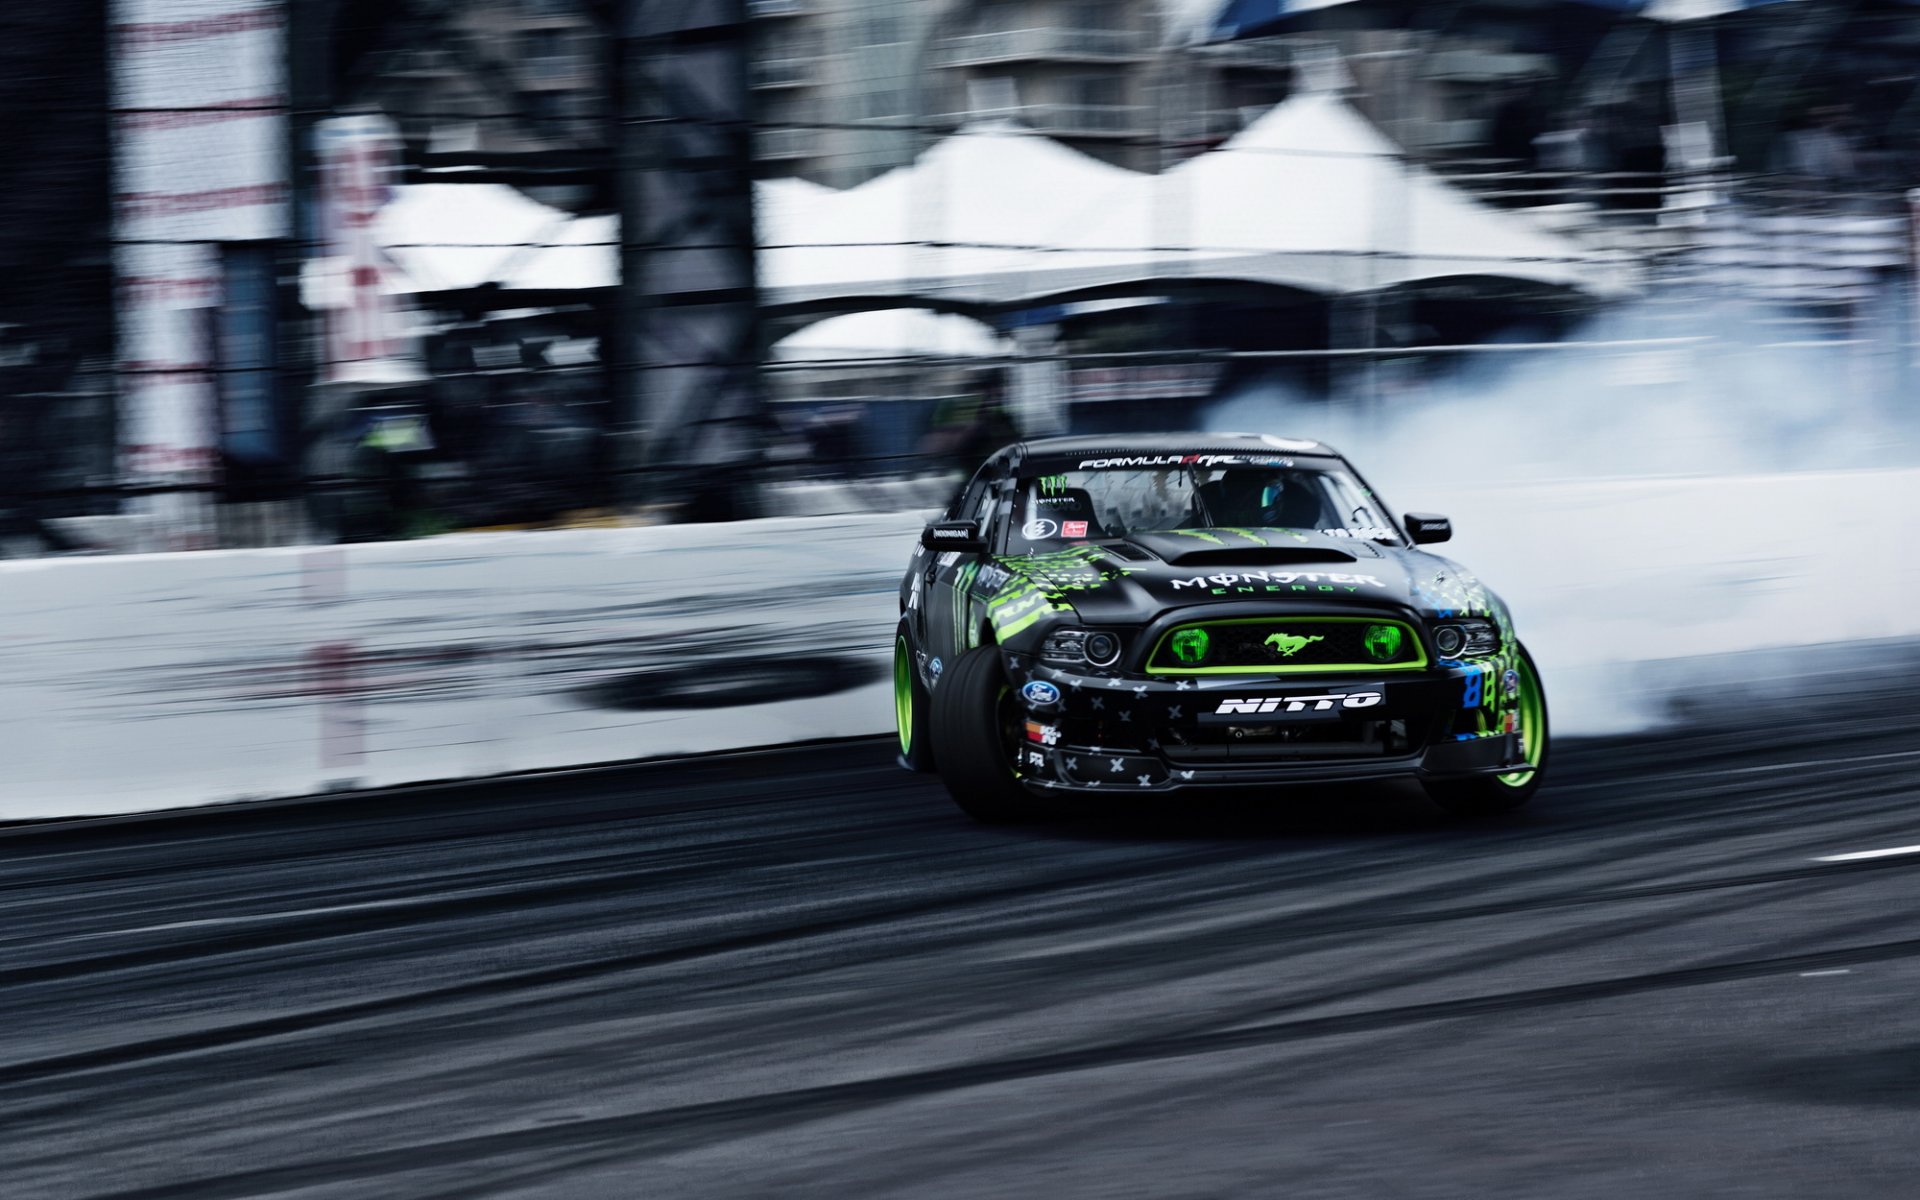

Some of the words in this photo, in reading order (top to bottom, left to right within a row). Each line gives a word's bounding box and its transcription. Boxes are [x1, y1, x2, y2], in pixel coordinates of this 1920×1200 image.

[1170, 570, 1386, 590] MONSTER
[1211, 585, 1360, 595] ENERGY
[1028, 683, 1055, 702] Ford
[1214, 692, 1382, 714] NITTO
